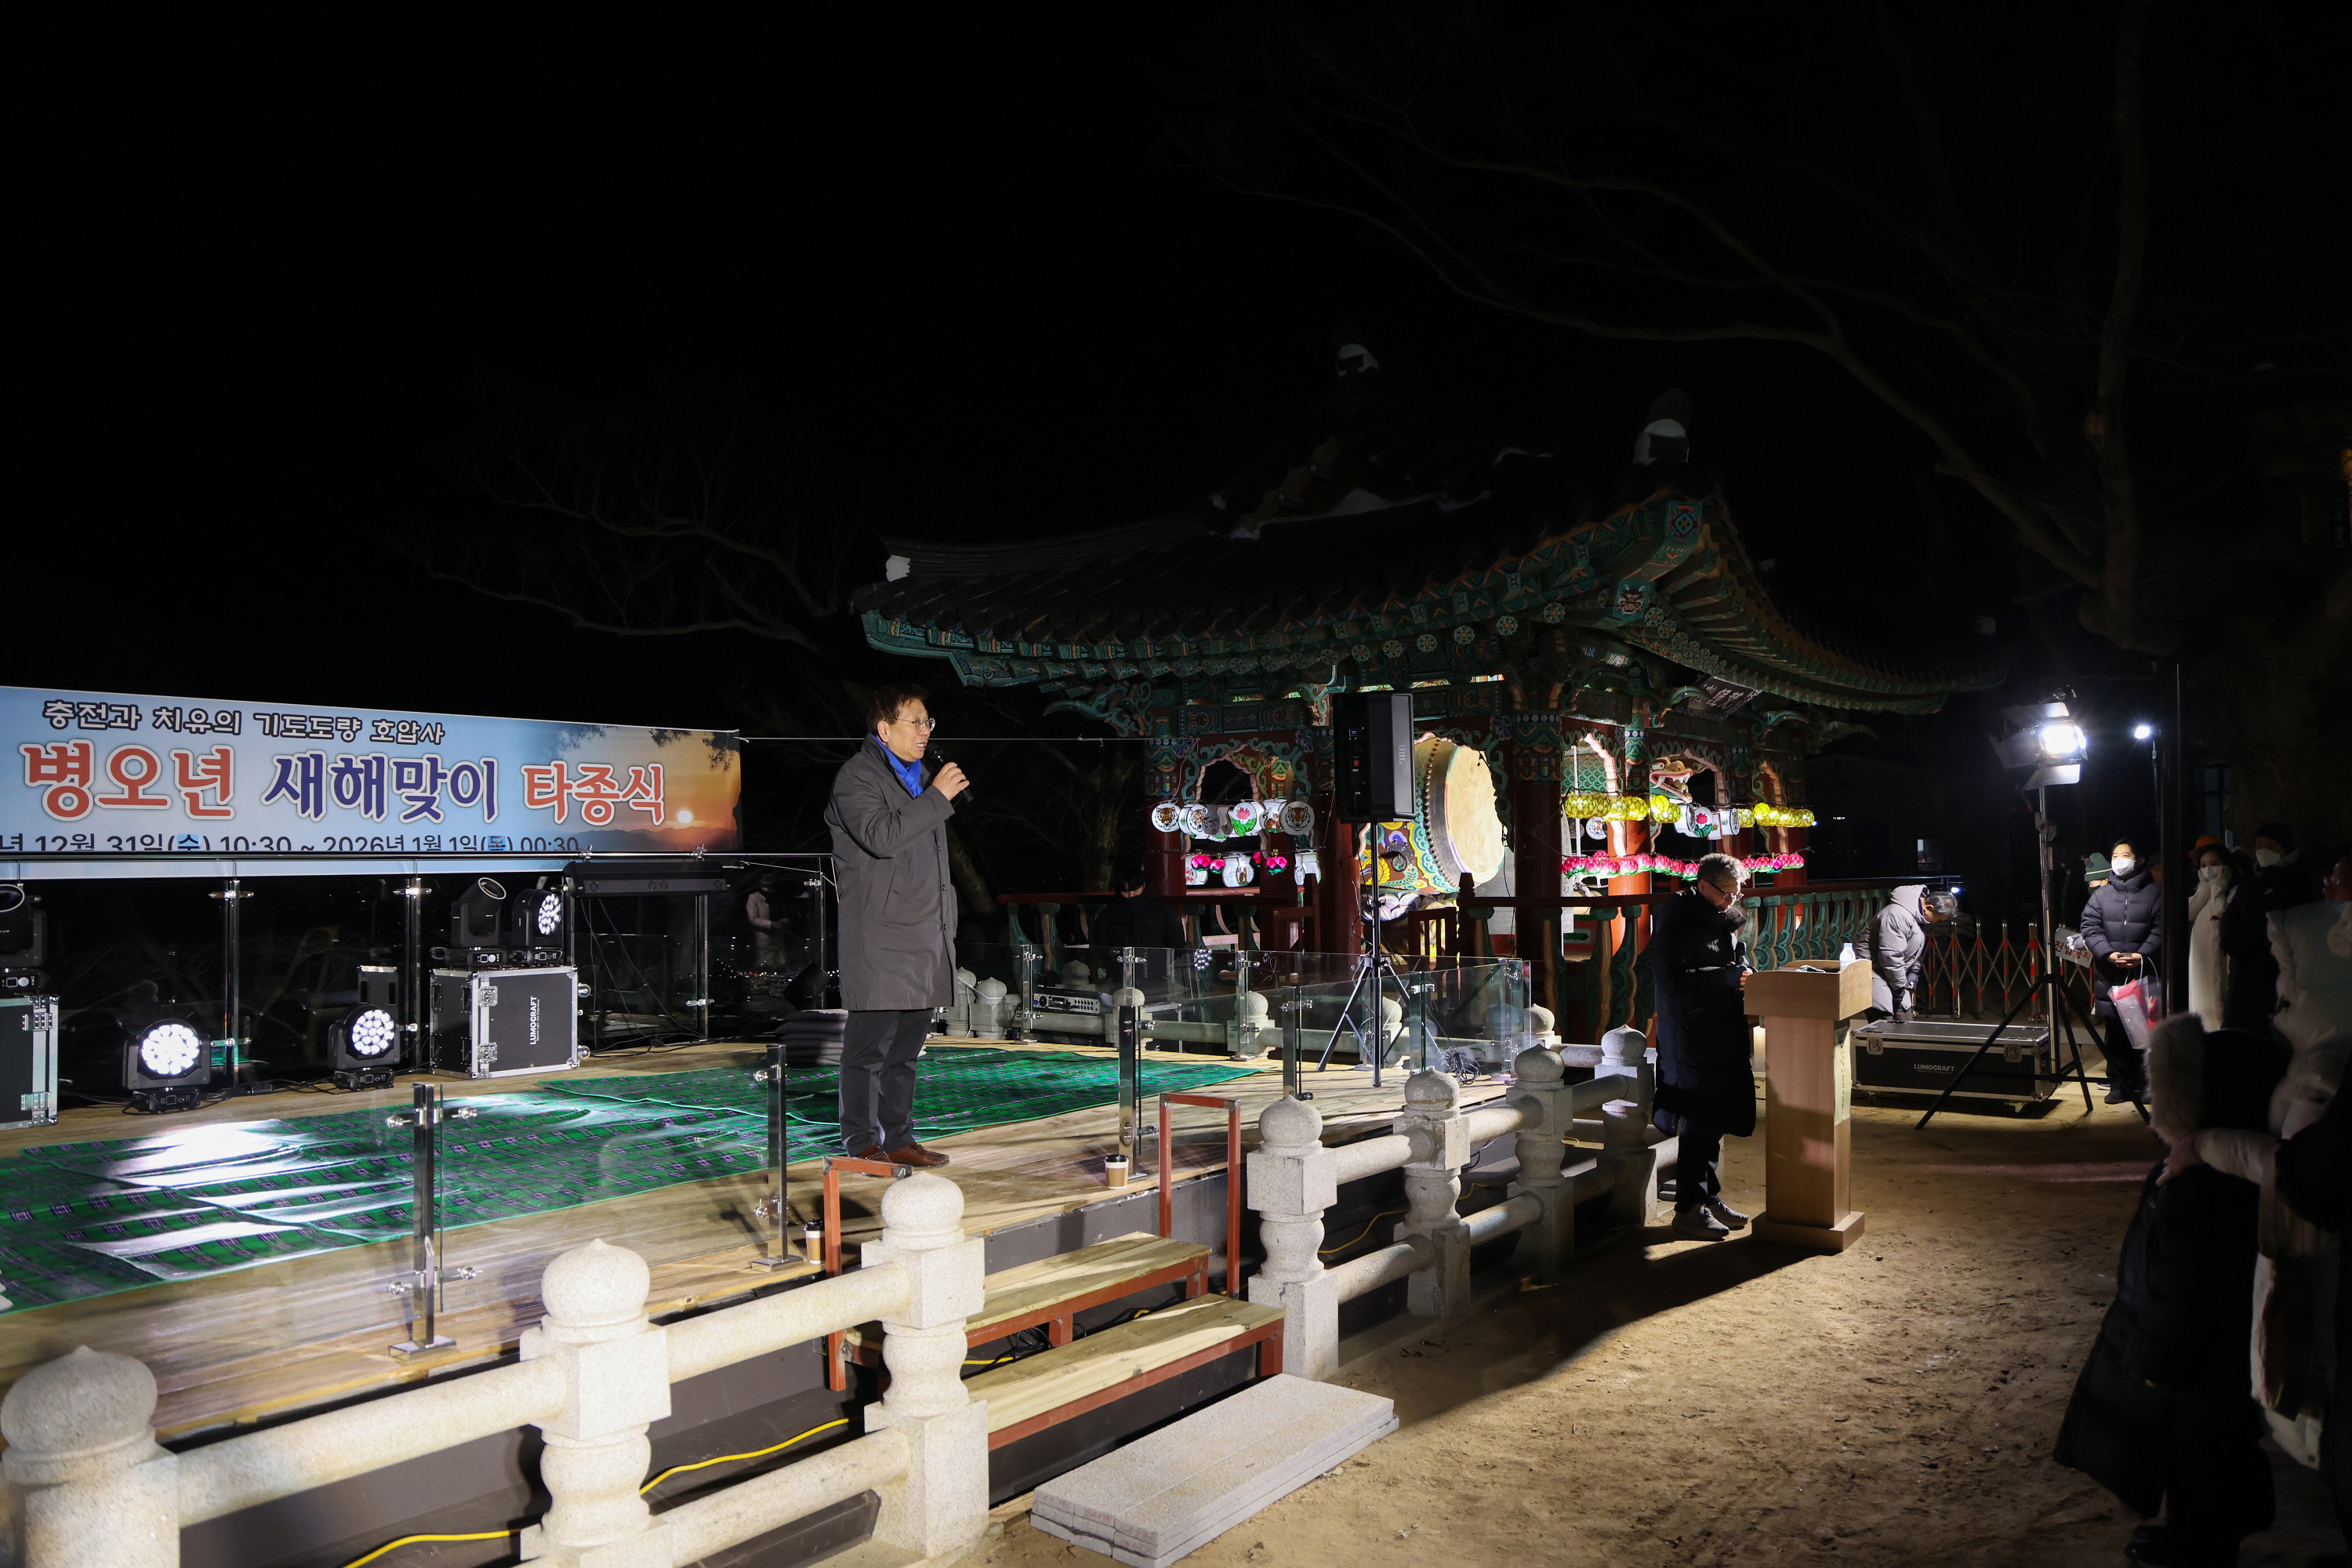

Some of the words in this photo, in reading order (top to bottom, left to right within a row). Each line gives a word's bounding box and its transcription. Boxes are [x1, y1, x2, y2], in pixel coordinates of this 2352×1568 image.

[44, 699, 142, 730] 충전과
[153, 706, 241, 735] 치유의
[253, 712, 362, 742] 기도도량
[369, 719, 445, 745] 호압사
[20, 739, 235, 821] 병오년
[261, 750, 498, 823] 새해맞이
[521, 760, 665, 826] 타종식
[220, 836, 292, 851] 10:30
[520, 837, 579, 851] 00:30
[1914, 1063, 1955, 1072] LUMOCRAFT
